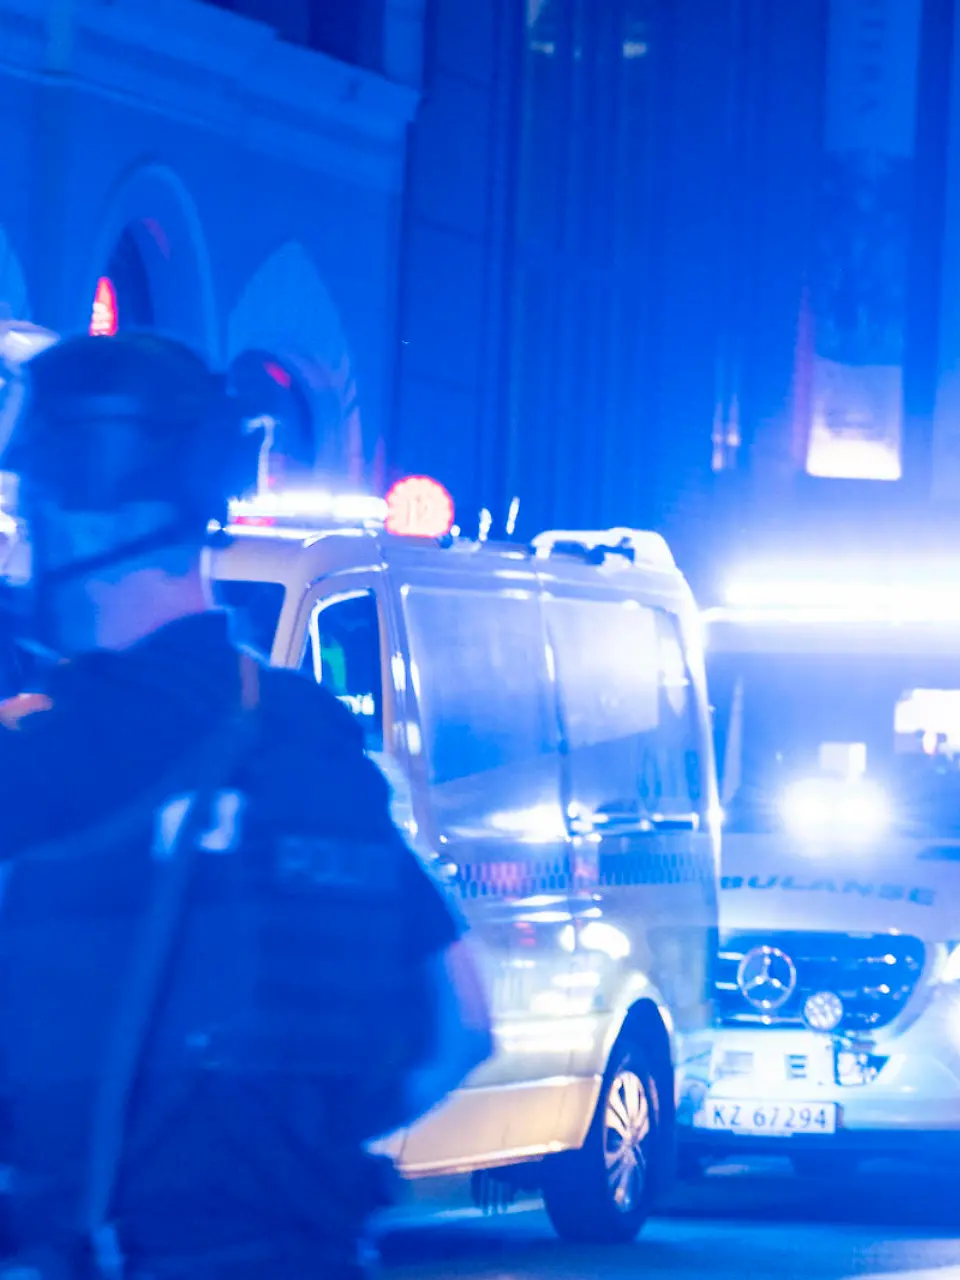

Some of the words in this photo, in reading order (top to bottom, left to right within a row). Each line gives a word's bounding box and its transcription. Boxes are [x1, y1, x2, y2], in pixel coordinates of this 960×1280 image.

[720, 876, 936, 906] BULANSE
[713, 1103, 742, 1127] KZ
[753, 1105, 827, 1129] 67294
